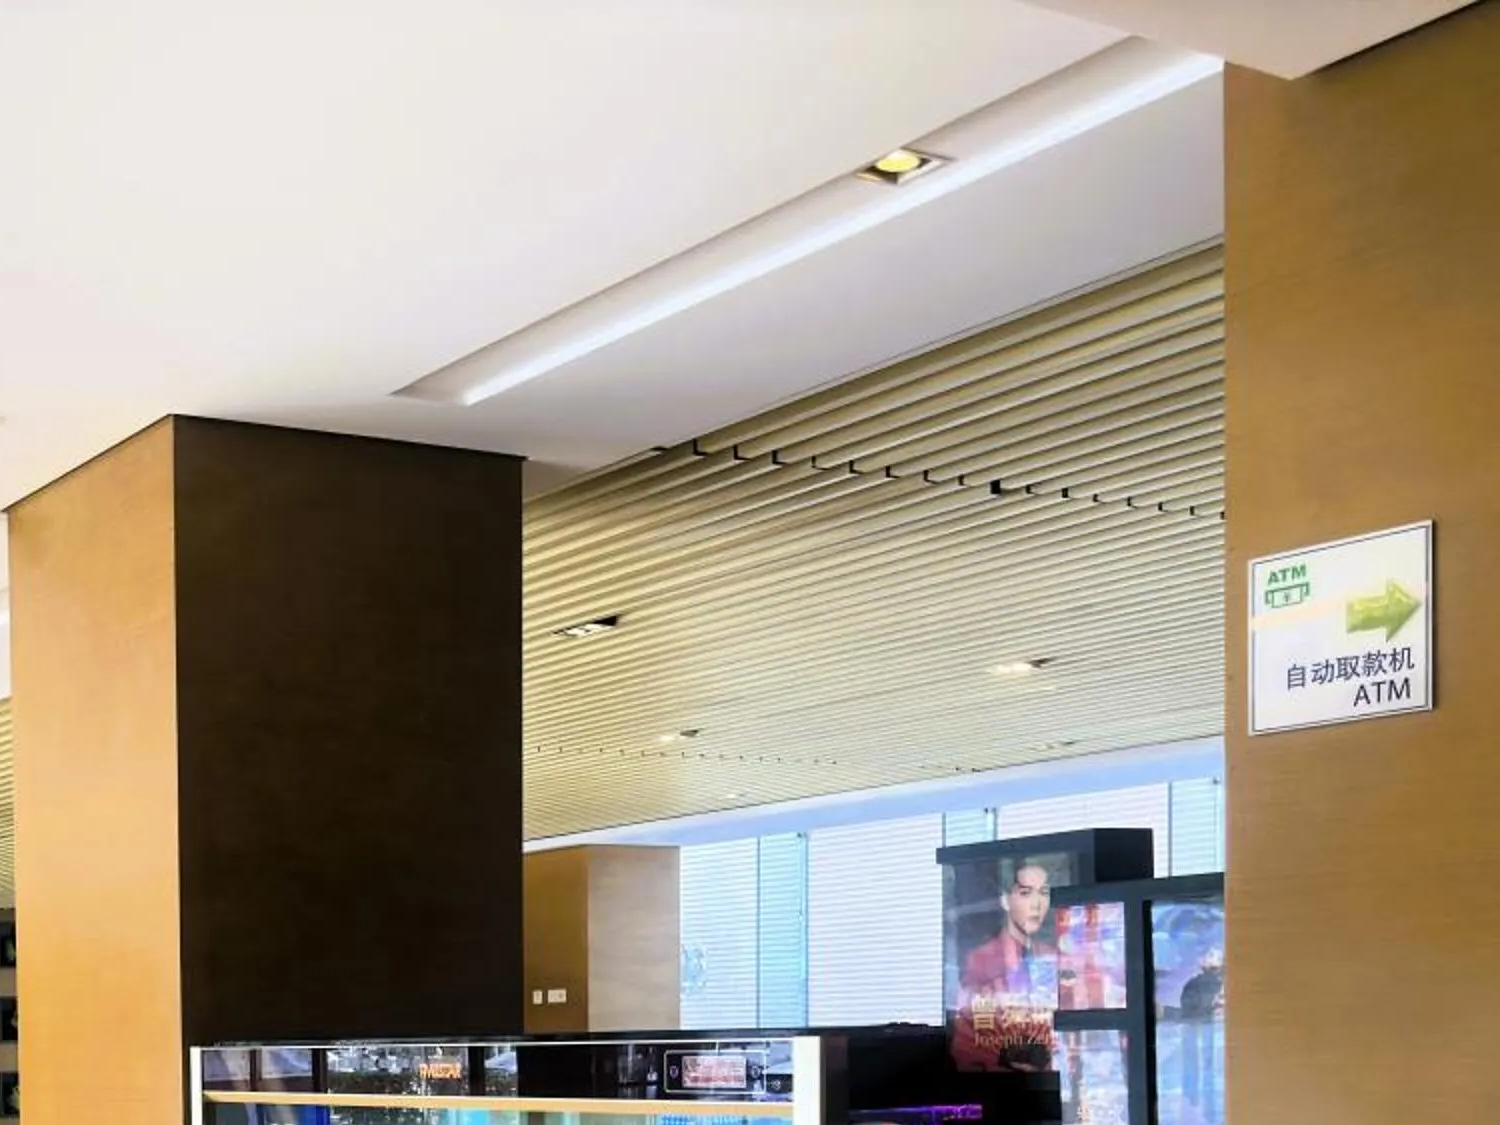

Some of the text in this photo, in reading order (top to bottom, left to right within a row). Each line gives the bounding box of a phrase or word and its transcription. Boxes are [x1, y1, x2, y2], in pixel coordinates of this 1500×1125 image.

[1267, 564, 1307, 586] ATM
[1286, 647, 1415, 690] 自动取款机
[1353, 677, 1411, 707] ATM
